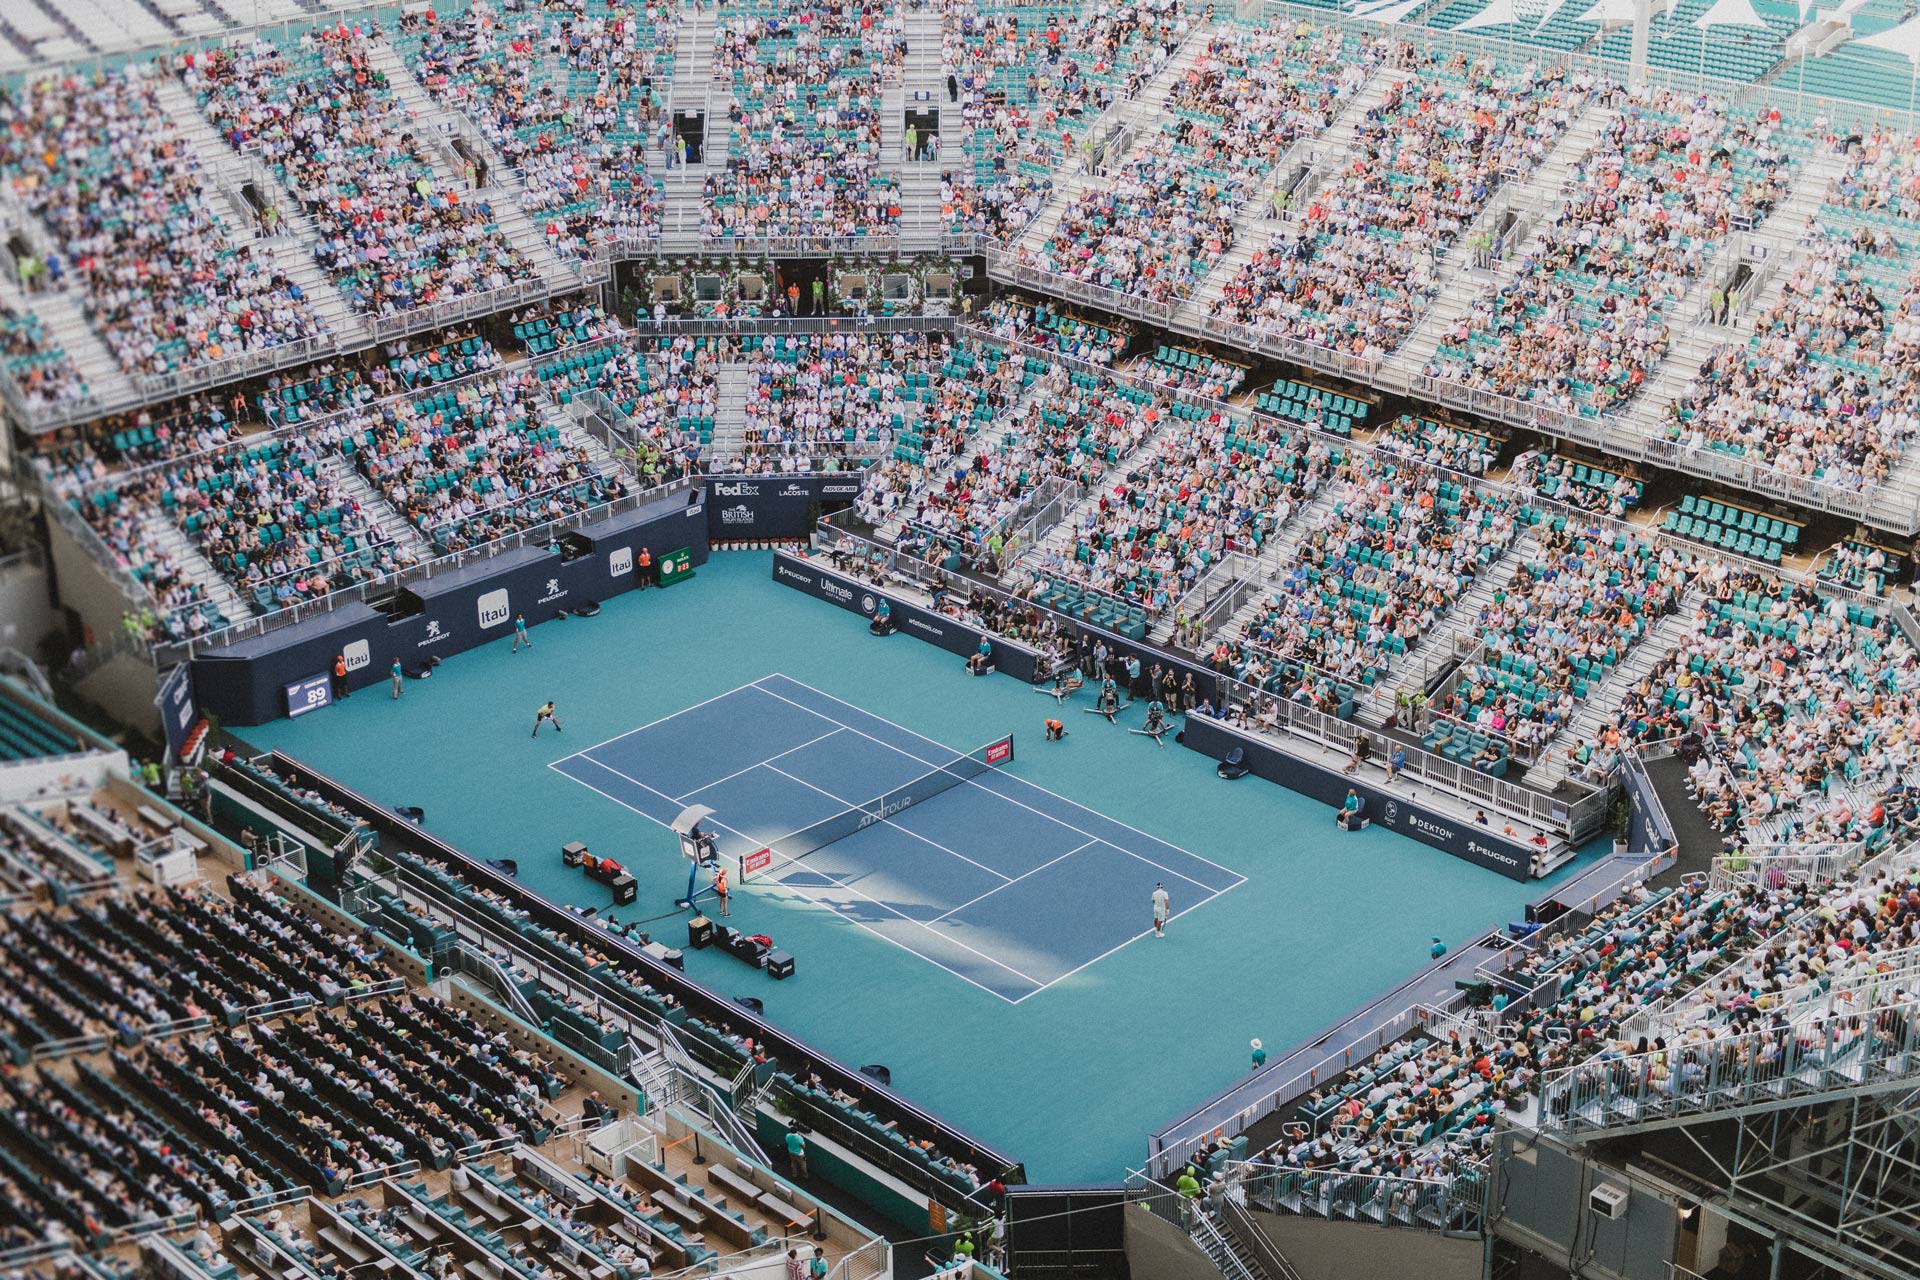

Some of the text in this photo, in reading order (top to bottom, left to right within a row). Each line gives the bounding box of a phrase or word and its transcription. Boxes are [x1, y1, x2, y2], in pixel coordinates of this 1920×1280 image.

[714, 482, 760, 496] FedEx
[822, 485, 858, 493] ADVOCARE
[721, 510, 754, 519] BRITISH
[612, 559, 631, 573] Itaú
[784, 569, 812, 584] PEUGEOT
[537, 589, 569, 604] PEUGEOT
[820, 578, 853, 600] Ultimate
[481, 604, 507, 624] Itaú
[908, 617, 943, 636] wtatennis.com
[417, 631, 451, 647] PEUGEOT
[346, 651, 368, 668] Itaú
[307, 686, 326, 704] 89
[987, 743, 1009, 757] Emirates
[883, 796, 912, 817] TOUR
[1417, 819, 1452, 839] DEKTON
[746, 852, 770, 866] Emirates
[1476, 845, 1518, 867] PEUGEOT
